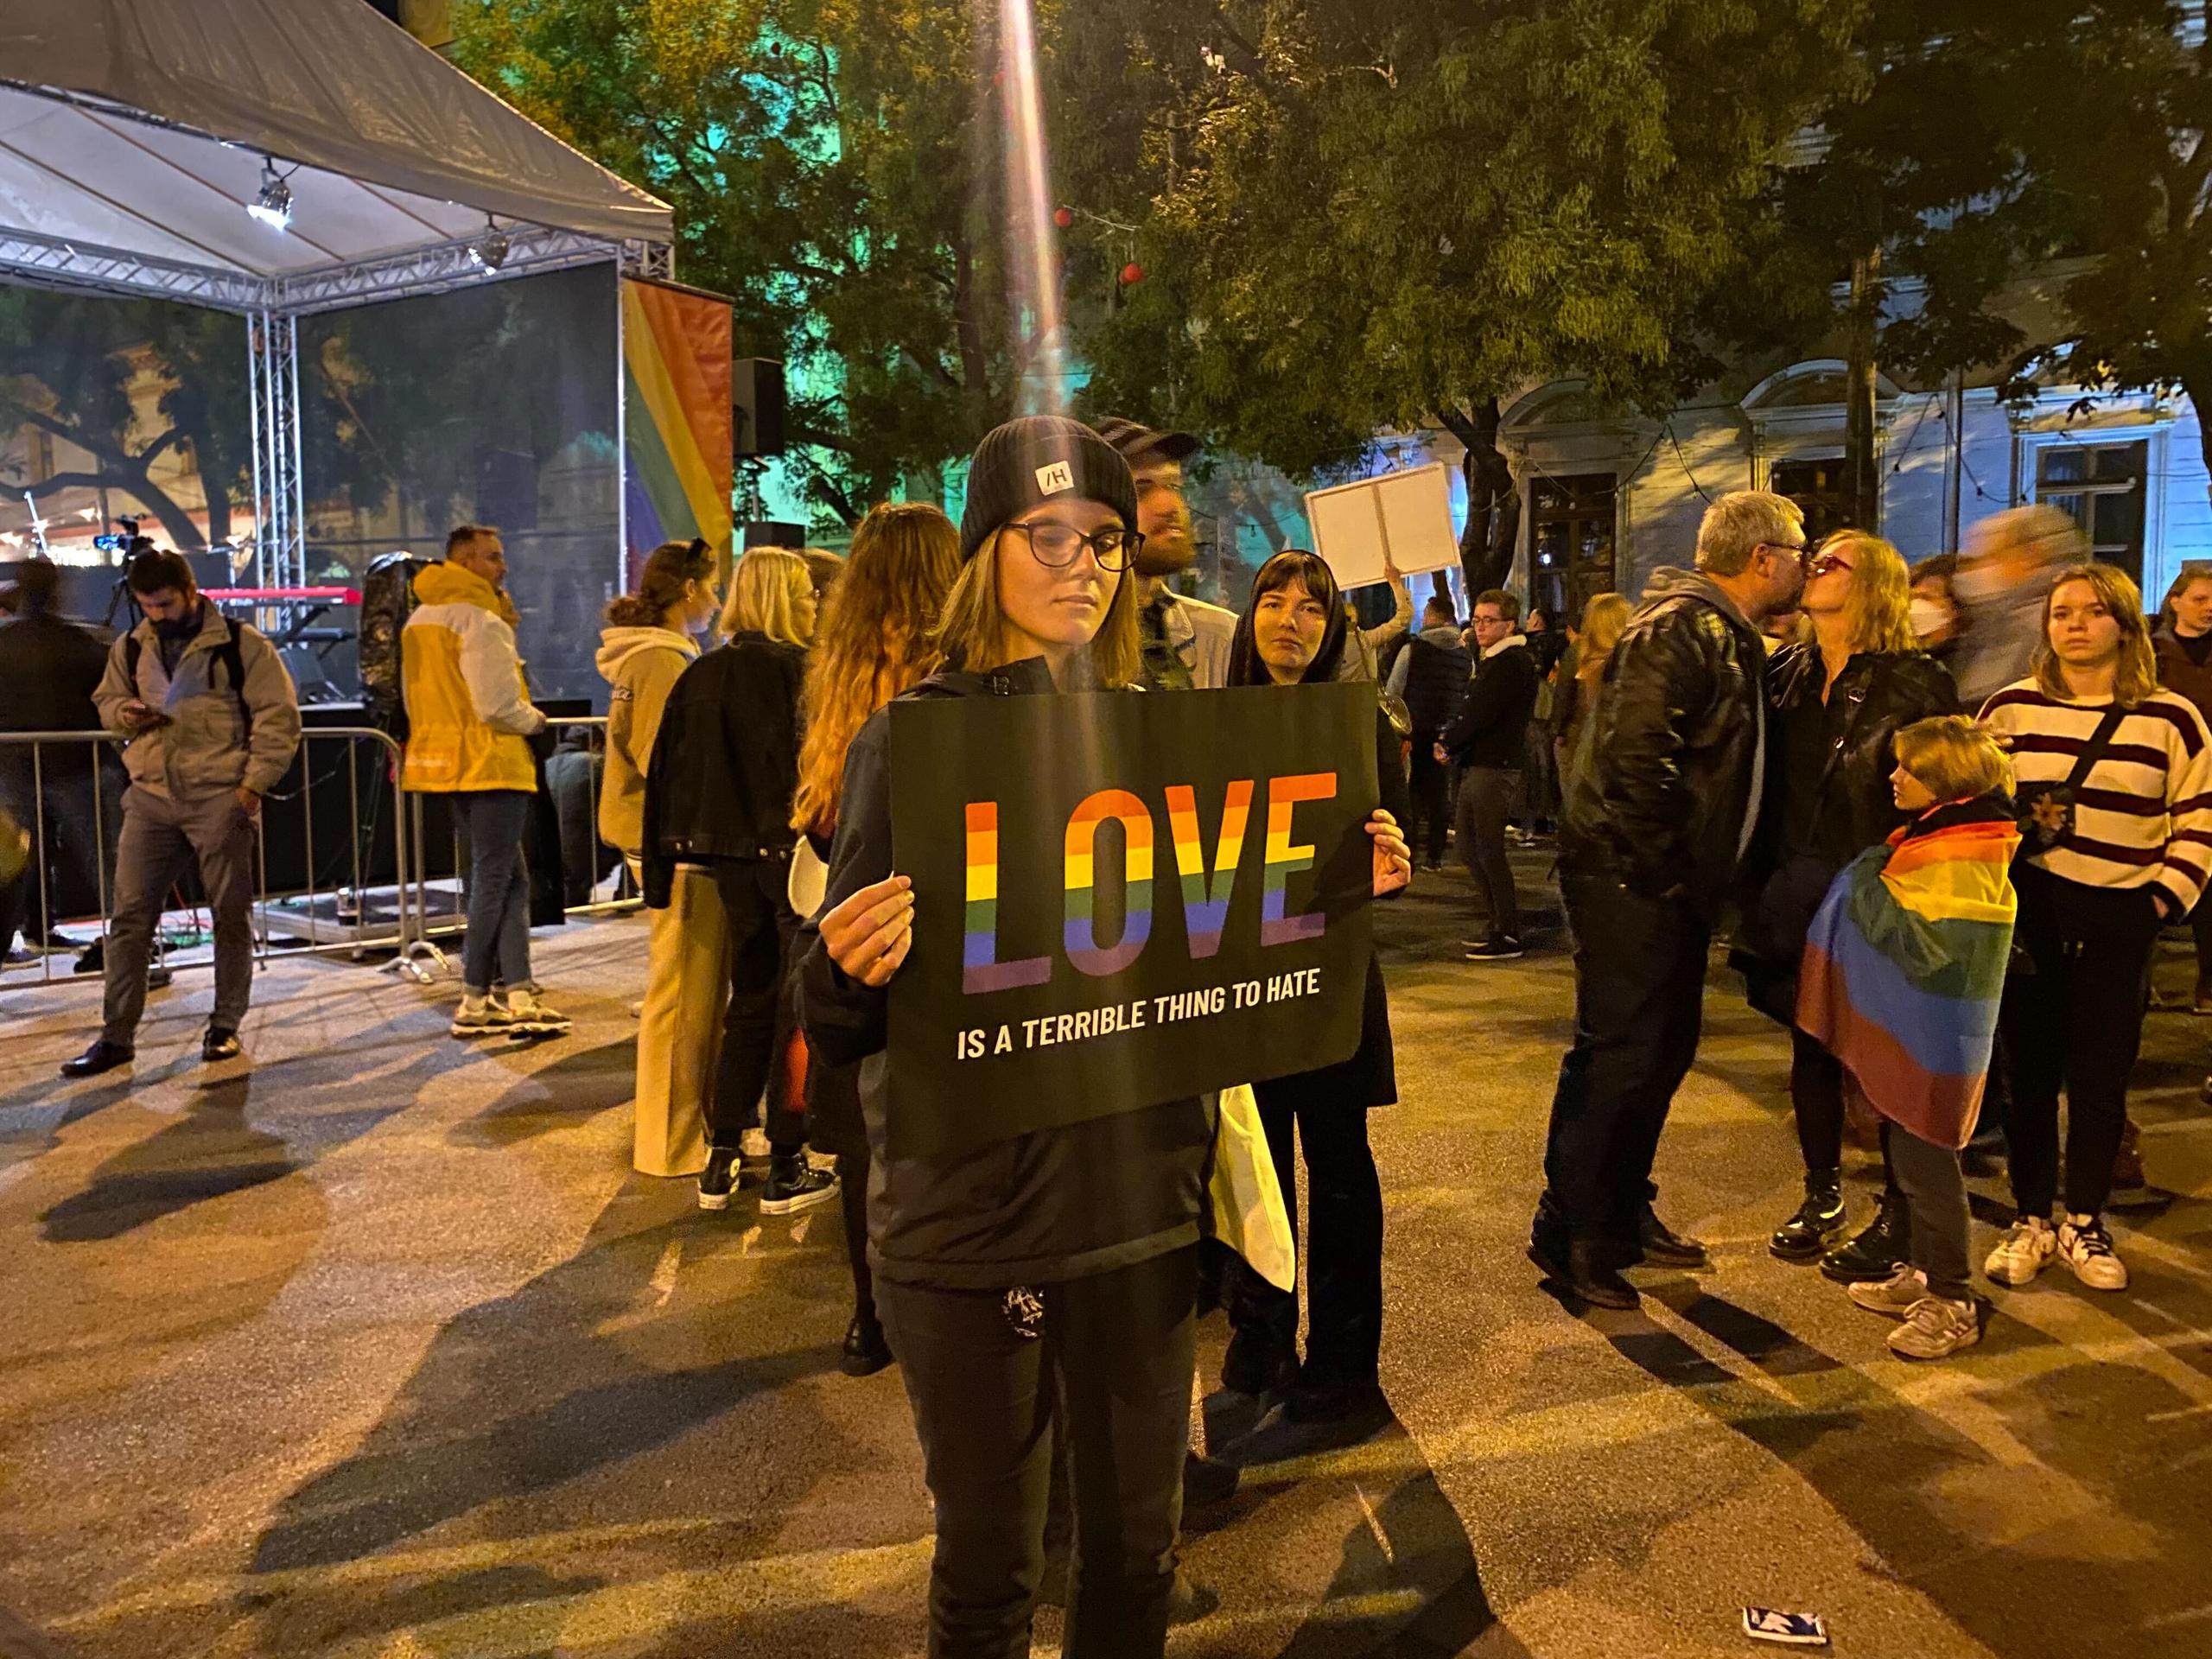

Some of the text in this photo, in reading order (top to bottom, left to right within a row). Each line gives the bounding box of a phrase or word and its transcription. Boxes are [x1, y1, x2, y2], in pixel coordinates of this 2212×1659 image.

[962, 772, 1338, 995] LOVE
[957, 968, 1321, 1060] IS A TERRIBLE THING TO HATE
